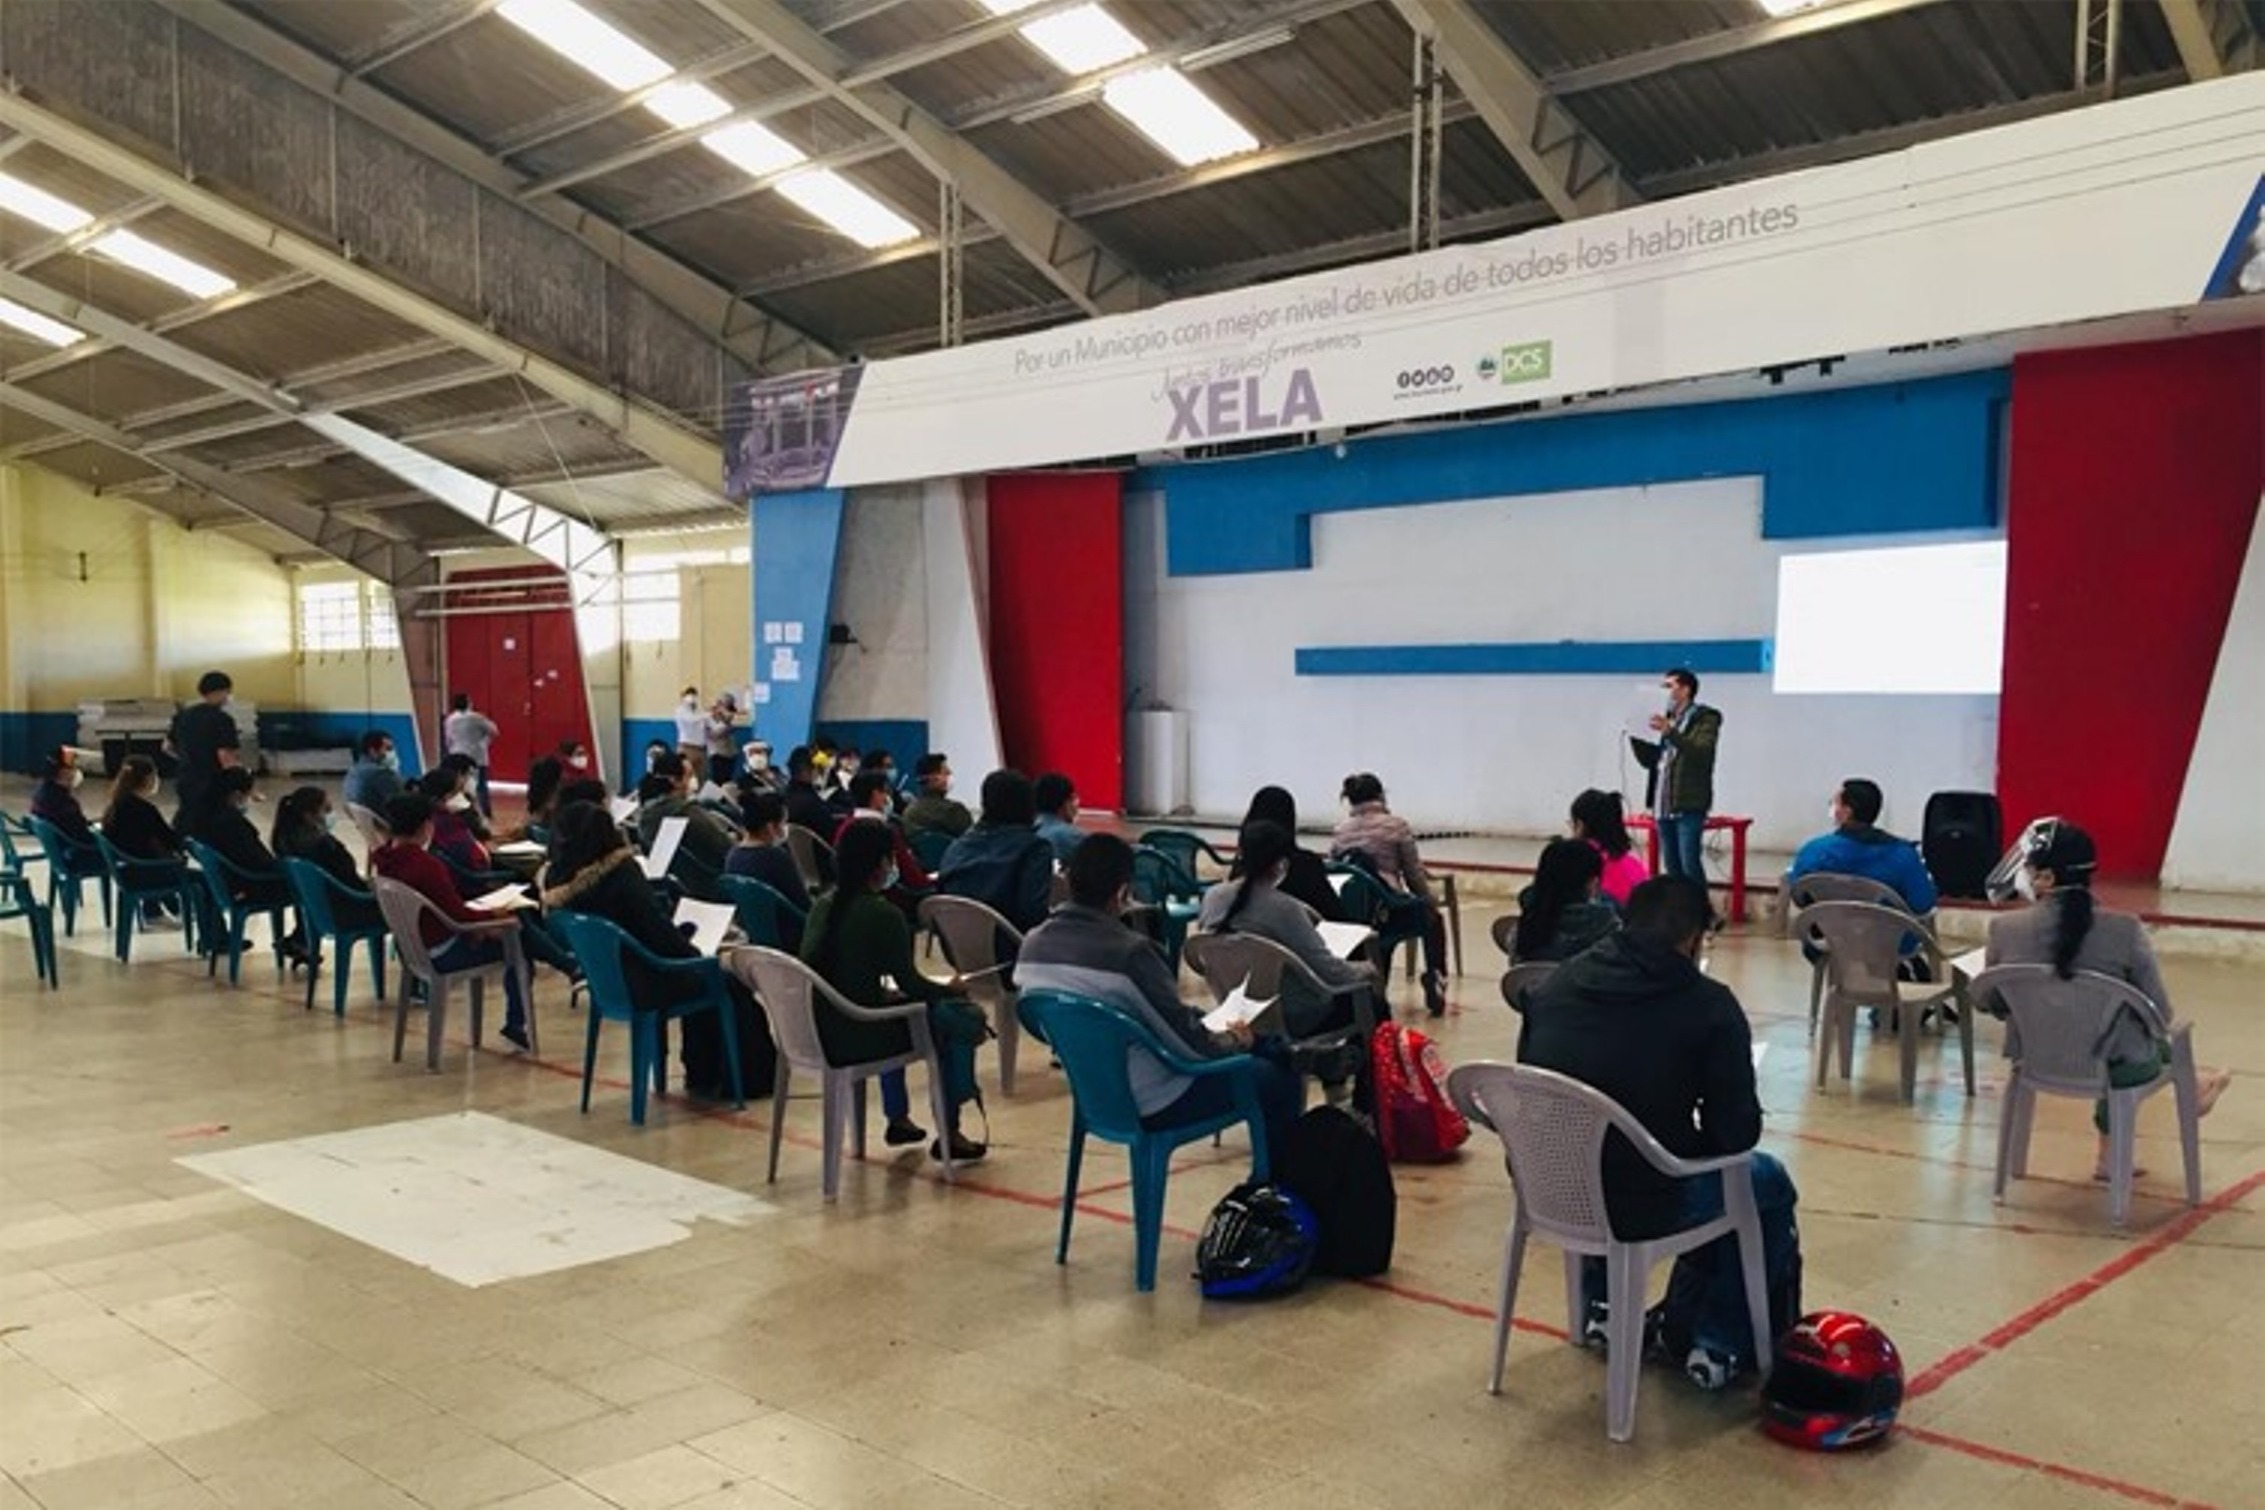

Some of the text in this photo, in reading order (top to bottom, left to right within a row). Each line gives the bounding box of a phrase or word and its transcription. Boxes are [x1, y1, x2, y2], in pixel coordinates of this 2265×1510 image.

[1014, 202, 1799, 374] Por un Municipio con mejor nivel de vida de todos los habitantes
[1504, 349, 1543, 374] DCS
[1165, 369, 1323, 442] XELA
